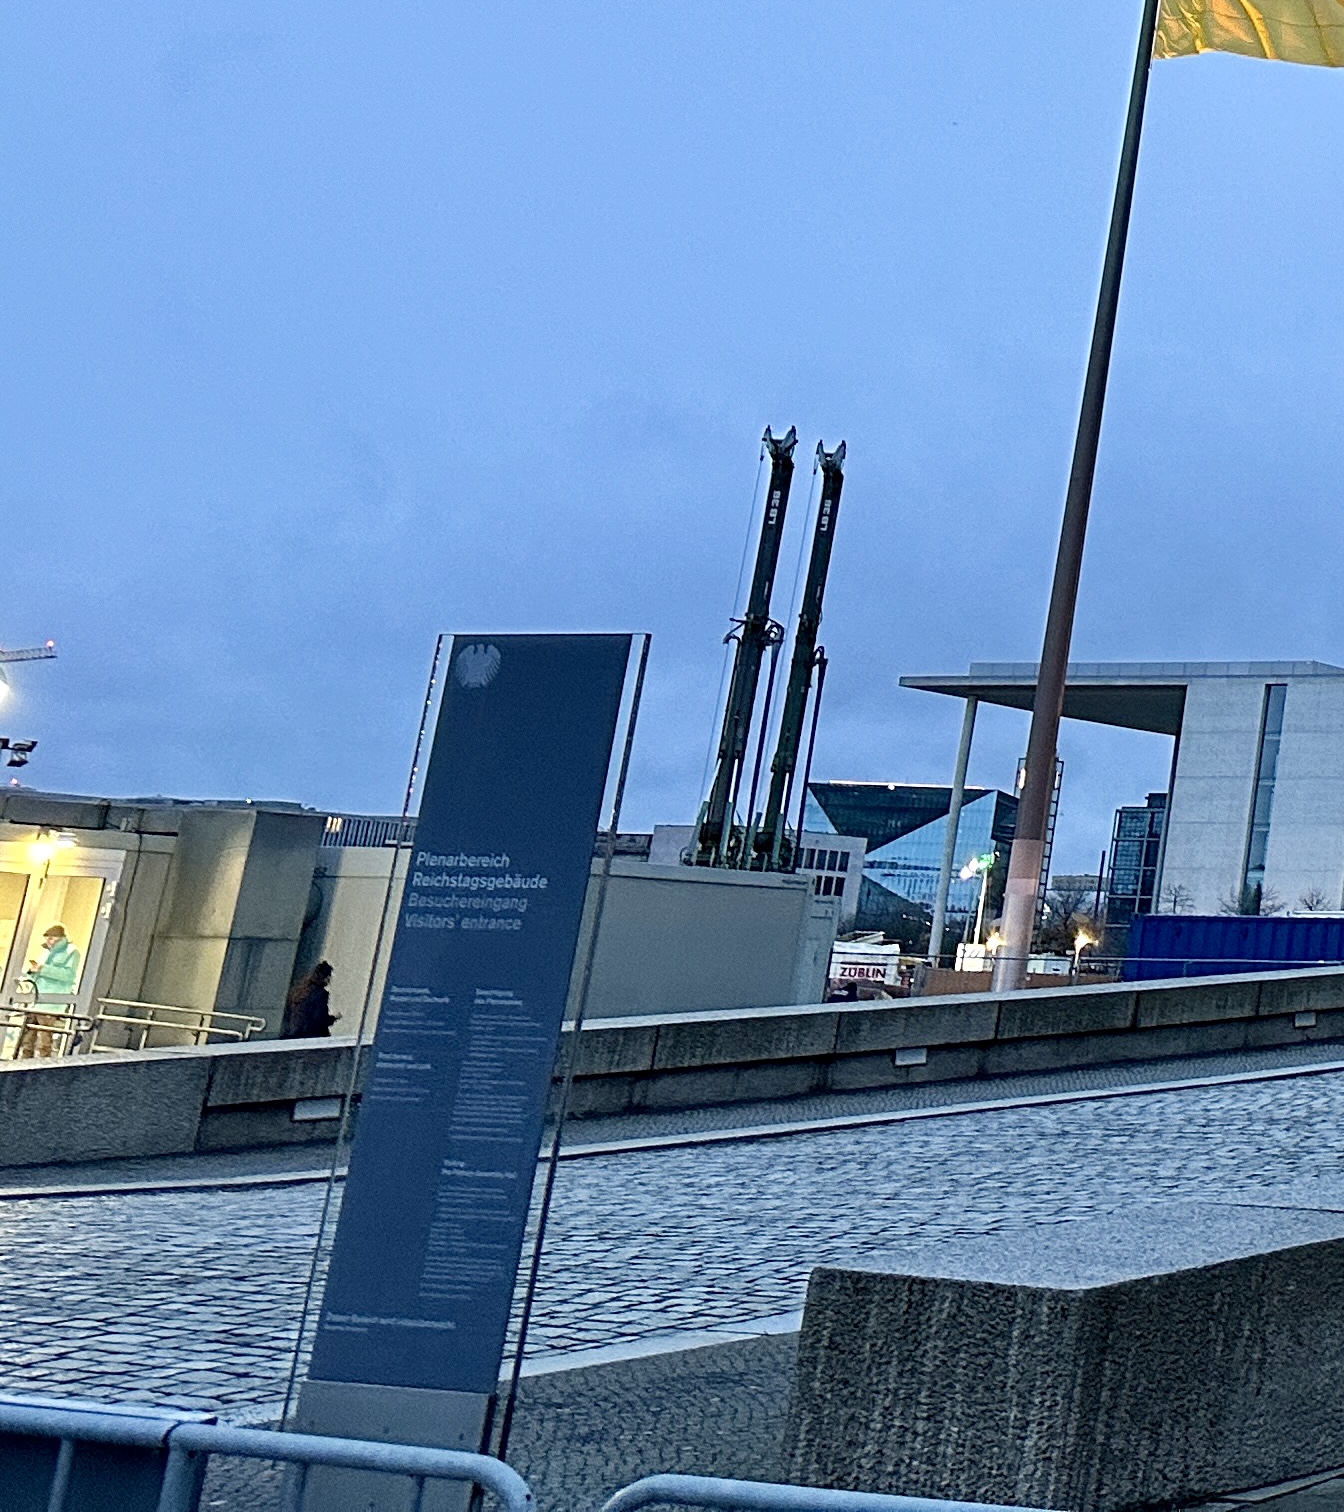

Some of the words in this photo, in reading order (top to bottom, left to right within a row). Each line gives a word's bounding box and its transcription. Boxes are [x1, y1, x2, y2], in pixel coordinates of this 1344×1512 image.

[415, 851, 510, 868] Plenarbereich
[412, 872, 549, 891] Reichstagsgebäude
[408, 892, 528, 912] Besuchereingang
[461, 914, 522, 931] entrance
